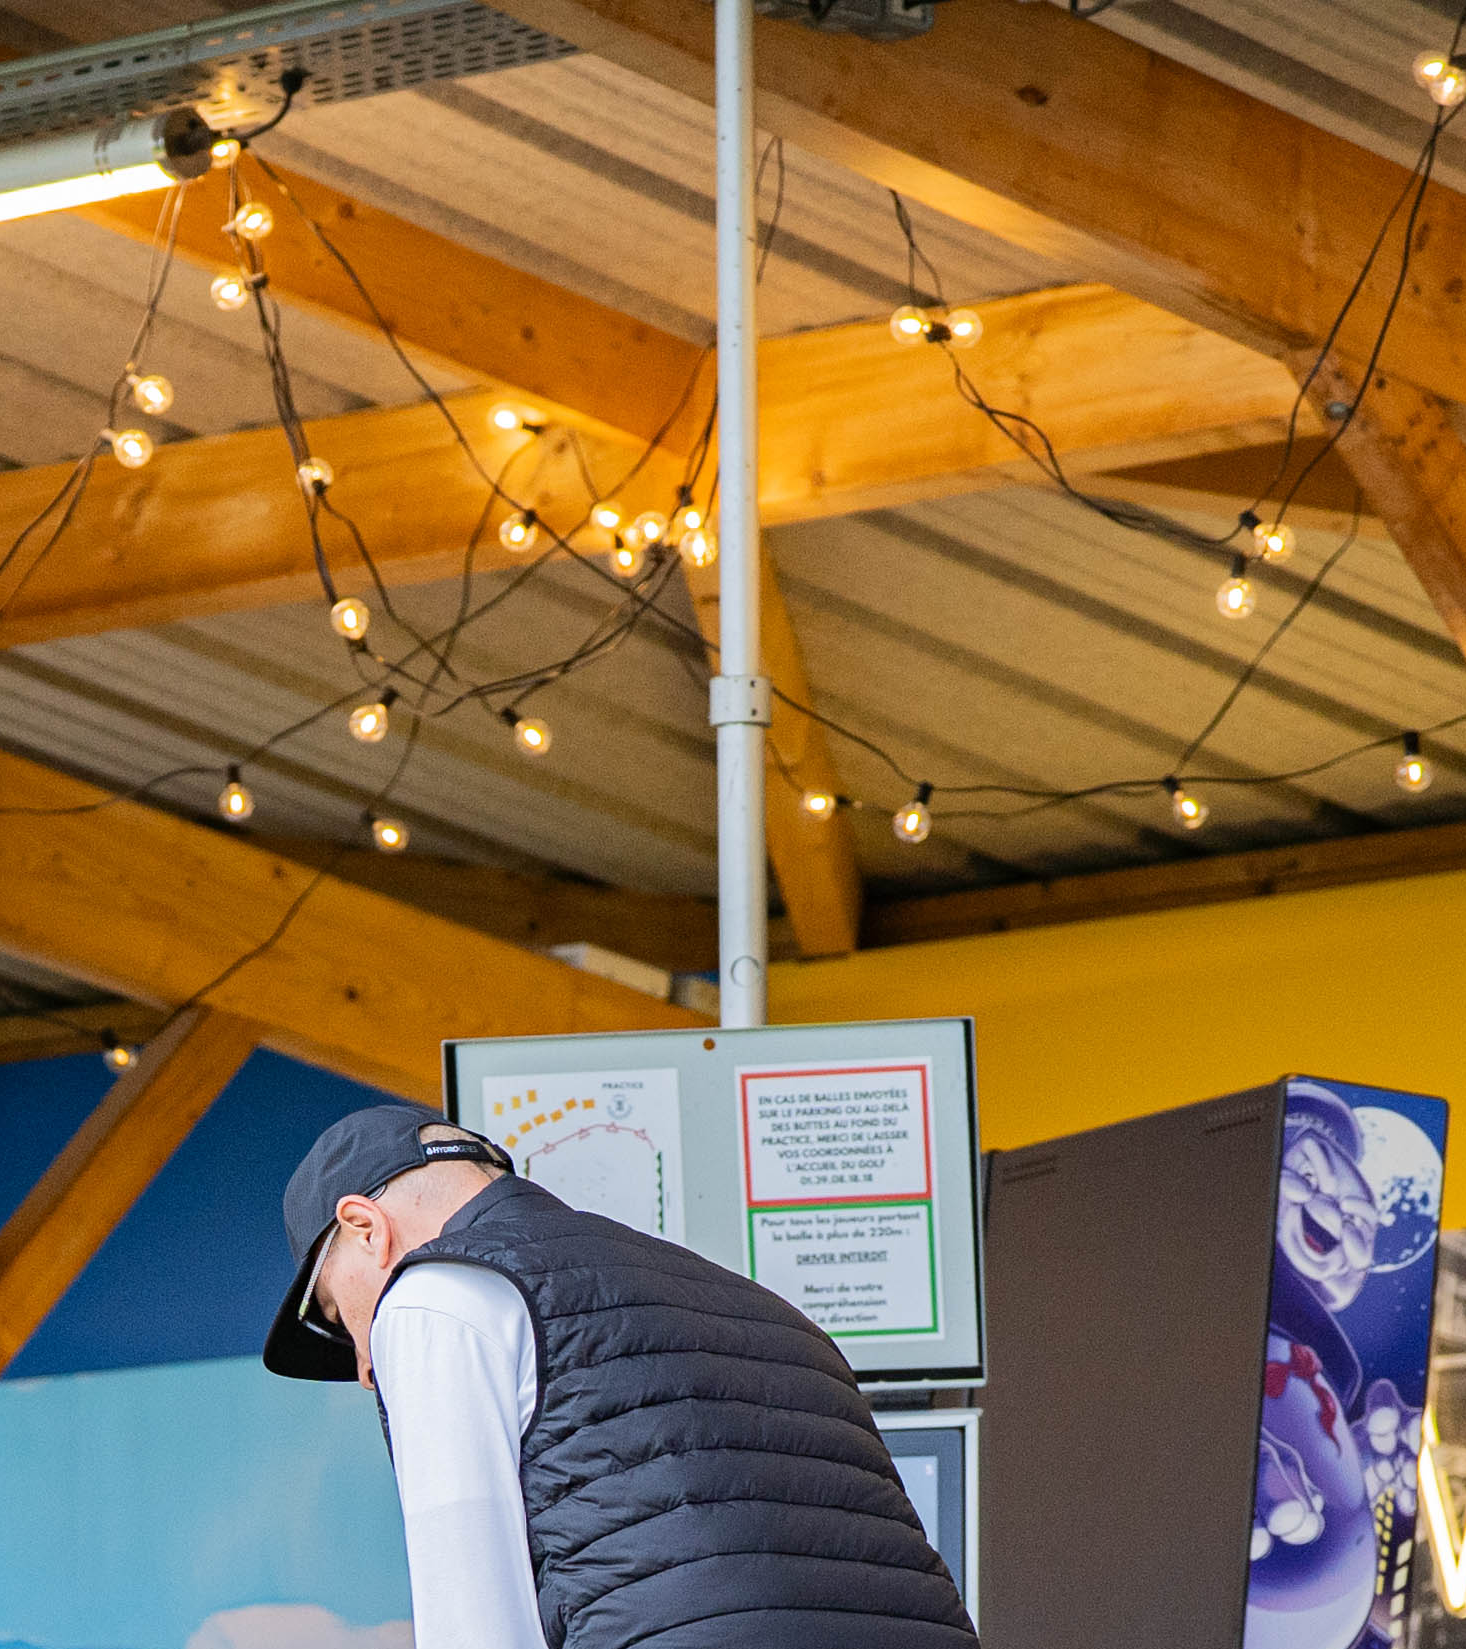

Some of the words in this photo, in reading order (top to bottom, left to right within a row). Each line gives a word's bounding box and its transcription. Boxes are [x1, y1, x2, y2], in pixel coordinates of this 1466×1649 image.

[759, 1095, 771, 1105] EN
[775, 1095, 795, 1104] CAS
[799, 1094, 811, 1103] DE
[815, 1092, 850, 1102] BALLES
[759, 1109, 778, 1119] SUR
[782, 1109, 793, 1118] LE
[795, 1107, 842, 1116] PARKING
[845, 1105, 861, 1114] OU
[772, 1122, 791, 1132] DES
[794, 1121, 830, 1131] BUTTES
[834, 1119, 848, 1129] AU
[851, 1118, 880, 1127] FOND
[883, 1117, 898, 1126] DU
[817, 1133, 848, 1143] MERCI
[852, 1132, 864, 1141] DE
[867, 1130, 909, 1140] LAISSER
[779, 1149, 800, 1159] VOS
[803, 1145, 883, 1158] COORDONNÉES
[841, 1161, 855, 1170] DU
[858, 1160, 885, 1169] GOLF
[796, 1253, 836, 1265] DRIVER
